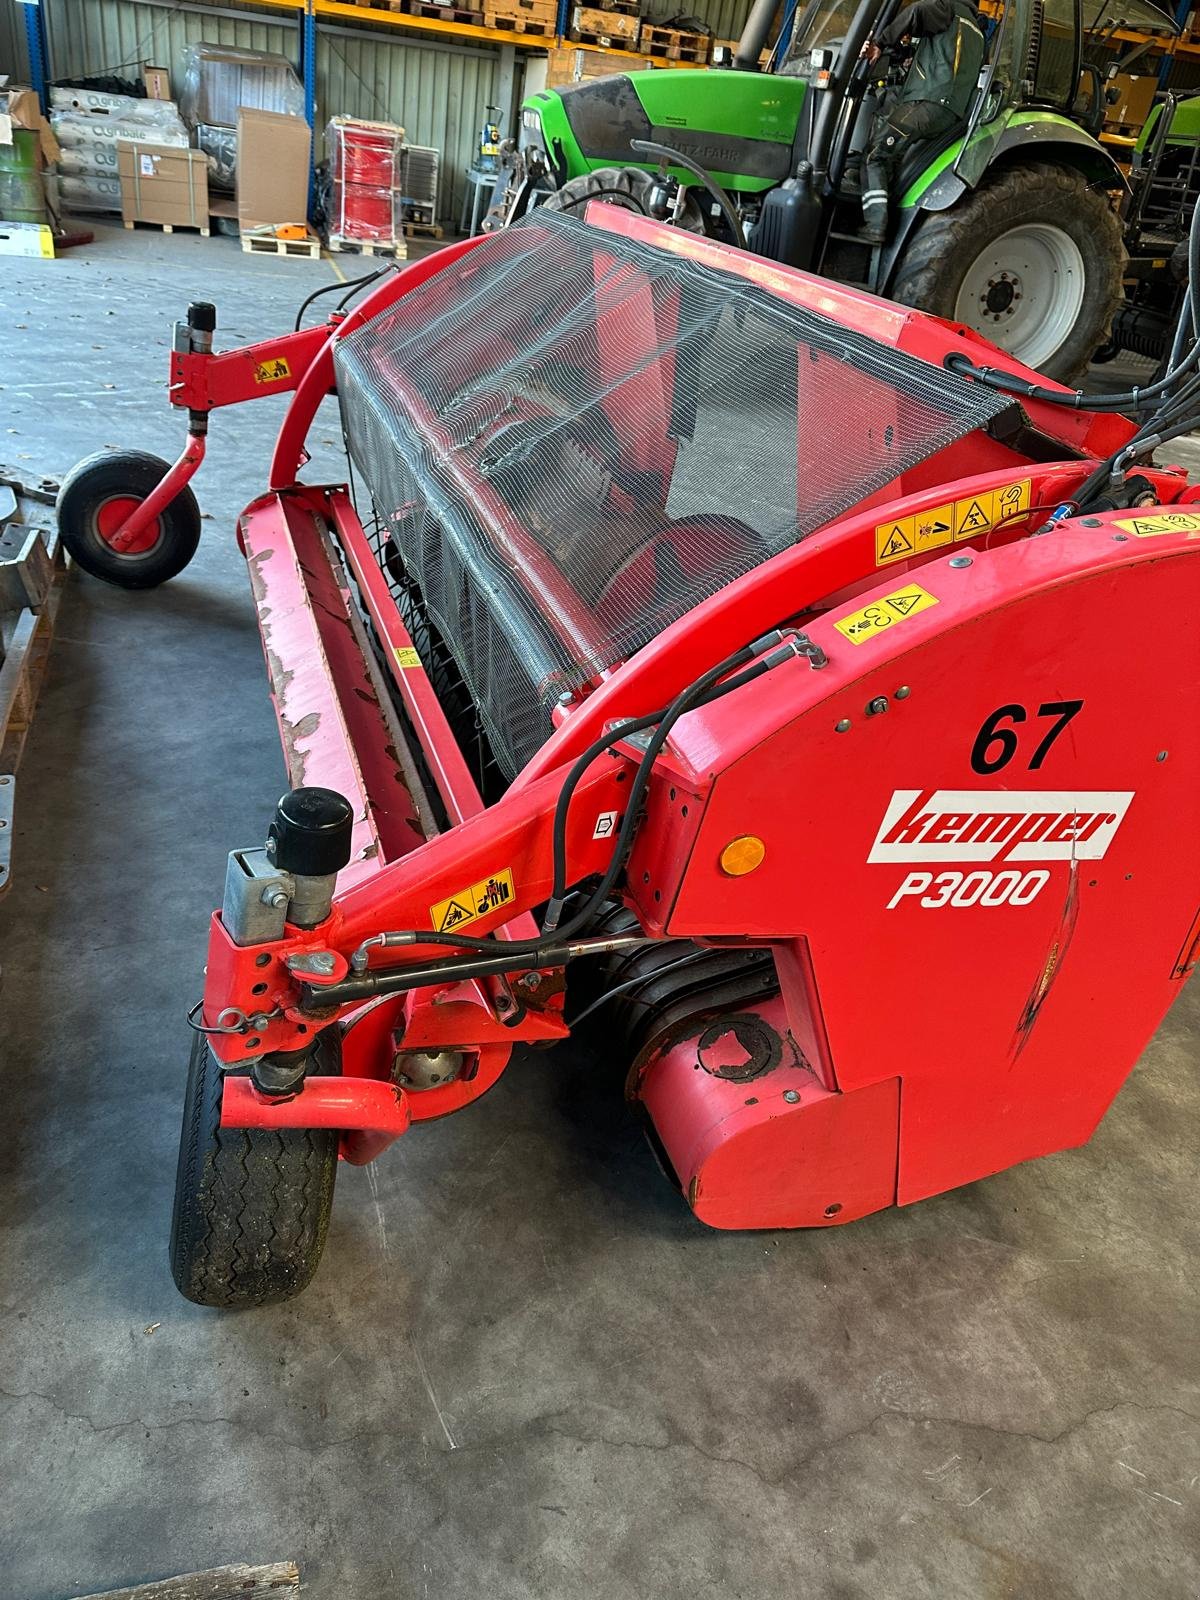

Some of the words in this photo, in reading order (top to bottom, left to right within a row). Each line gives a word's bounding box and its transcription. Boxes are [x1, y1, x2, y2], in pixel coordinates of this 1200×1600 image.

[970, 699, 1085, 776] 67
[879, 790, 1118, 863] kemper
[886, 869, 1052, 910] P3000
